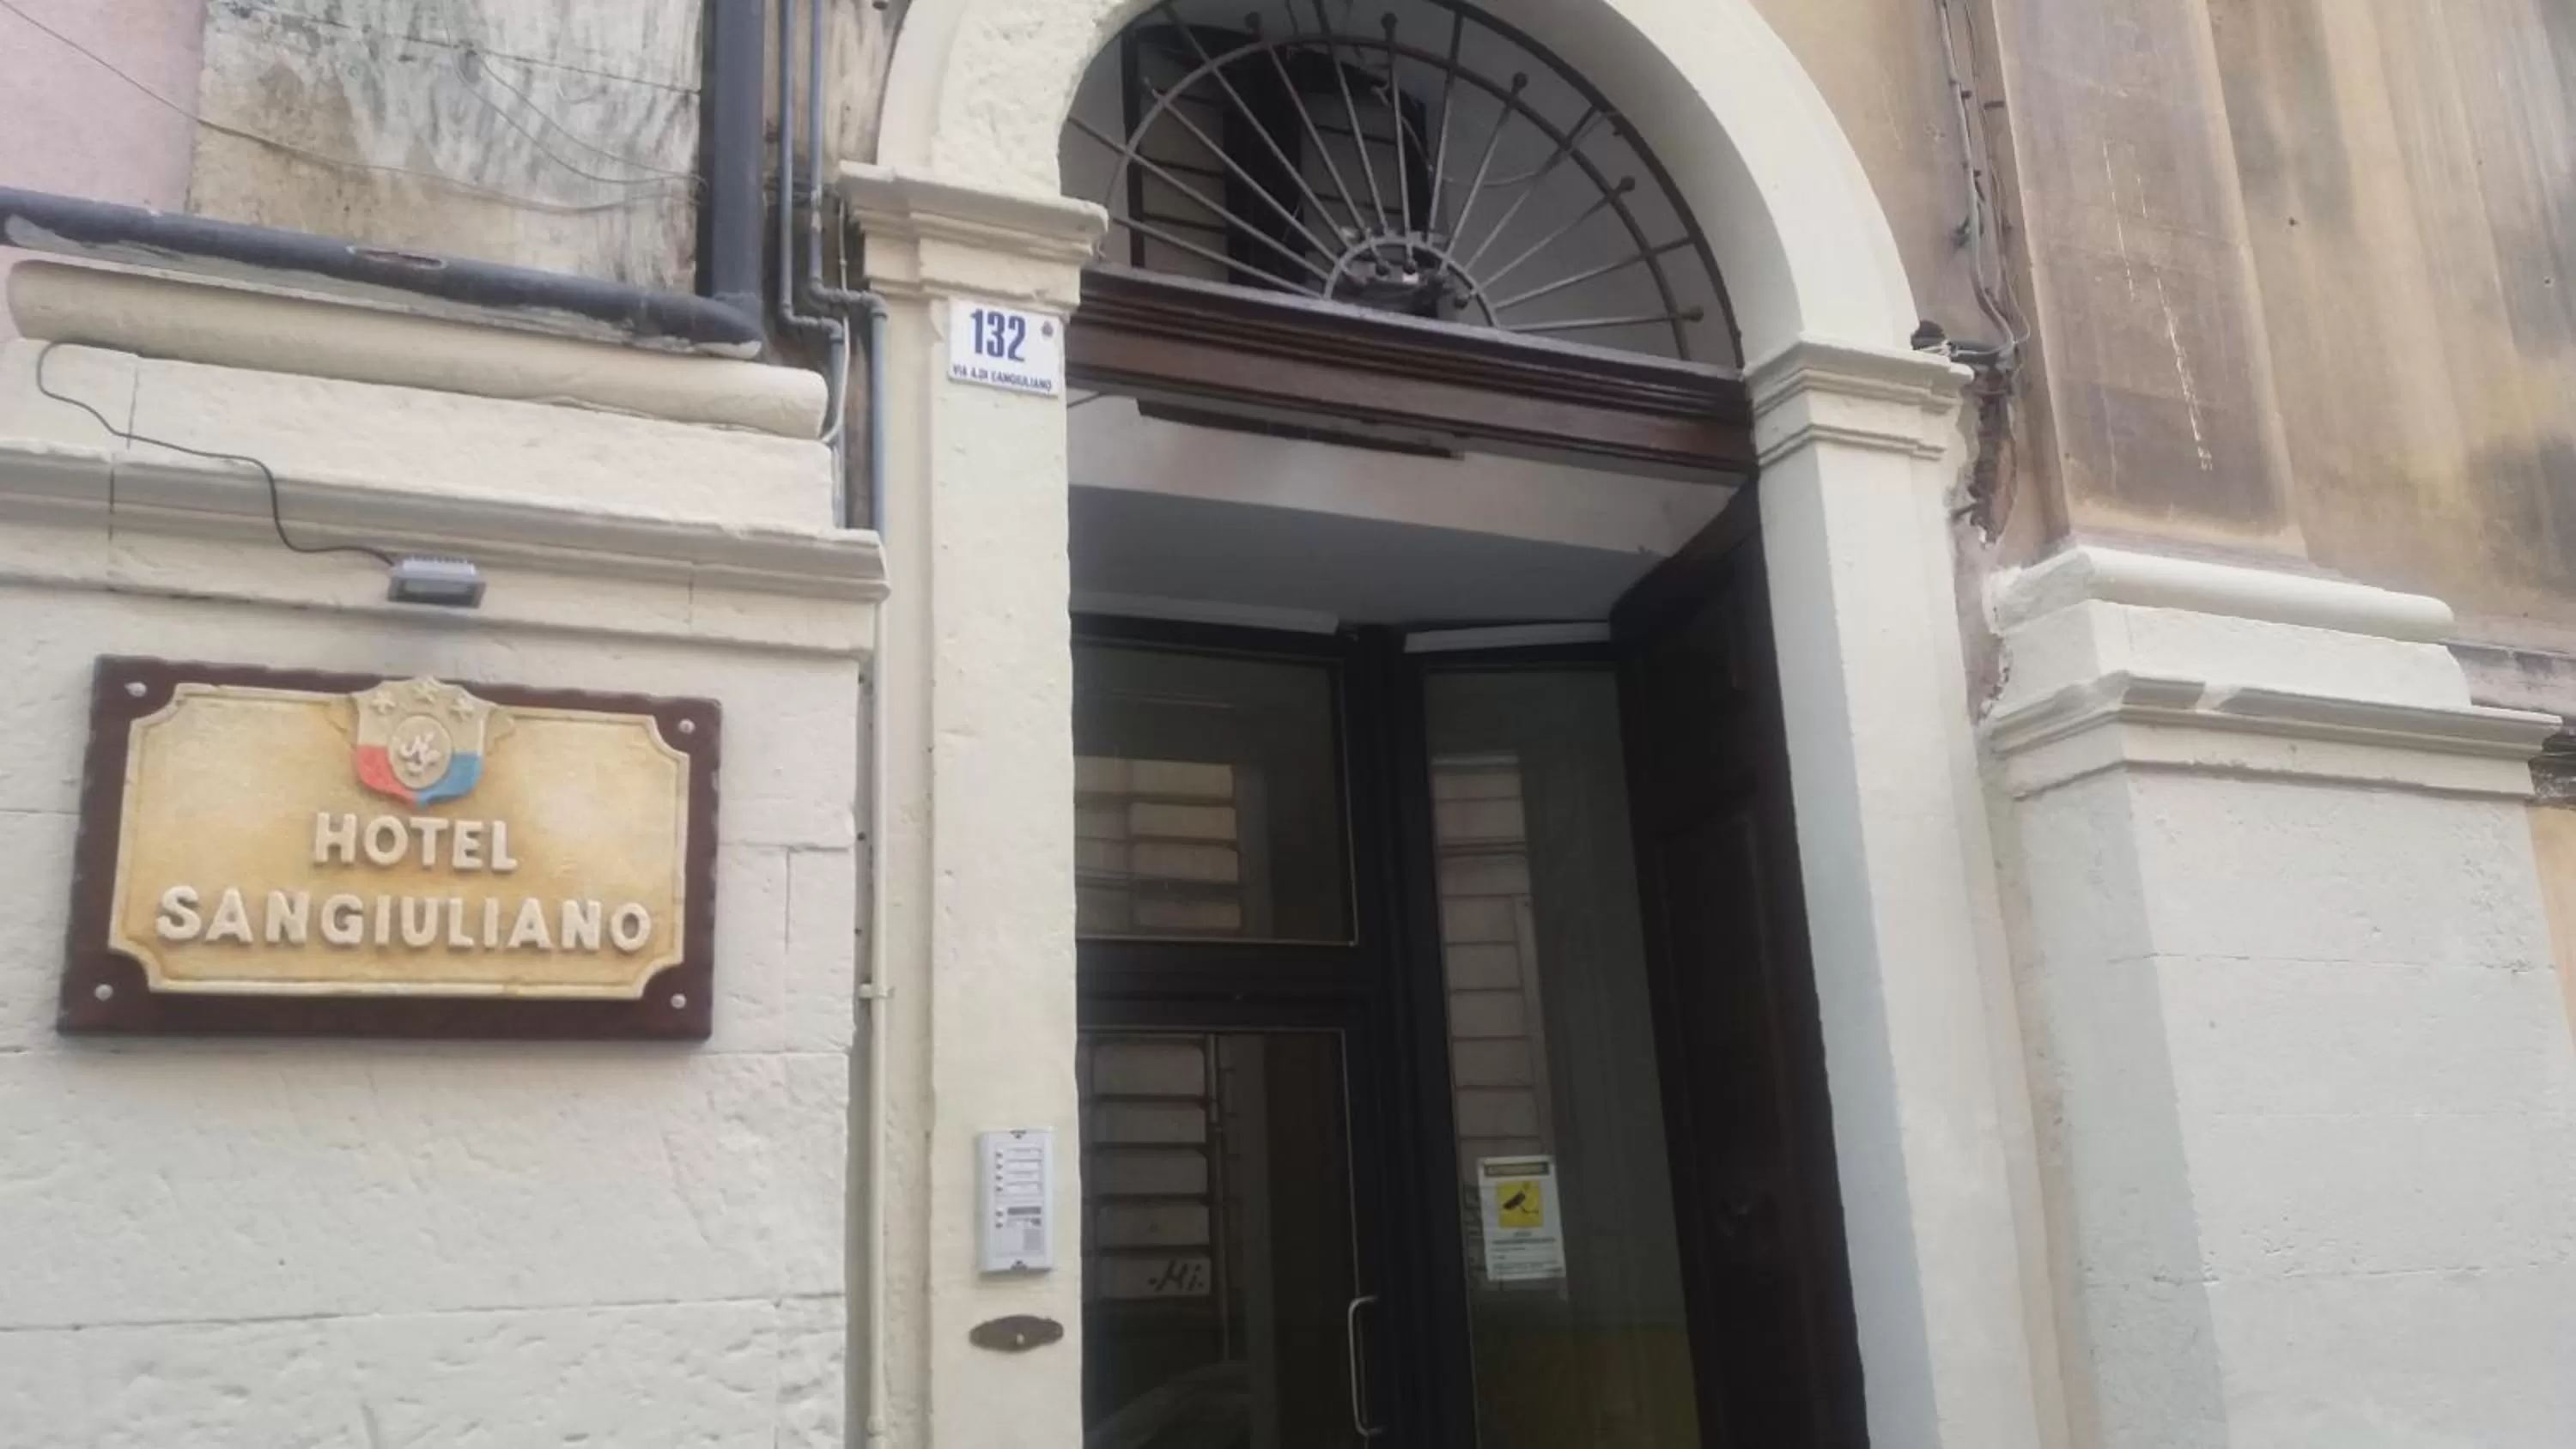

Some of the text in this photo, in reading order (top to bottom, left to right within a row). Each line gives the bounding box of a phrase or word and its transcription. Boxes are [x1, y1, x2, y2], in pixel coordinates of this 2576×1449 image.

[970, 308, 1025, 362] 132
[953, 364, 967, 377] VIA
[314, 810, 517, 871] HOTEL
[155, 885, 651, 954] SANGIULIANO
